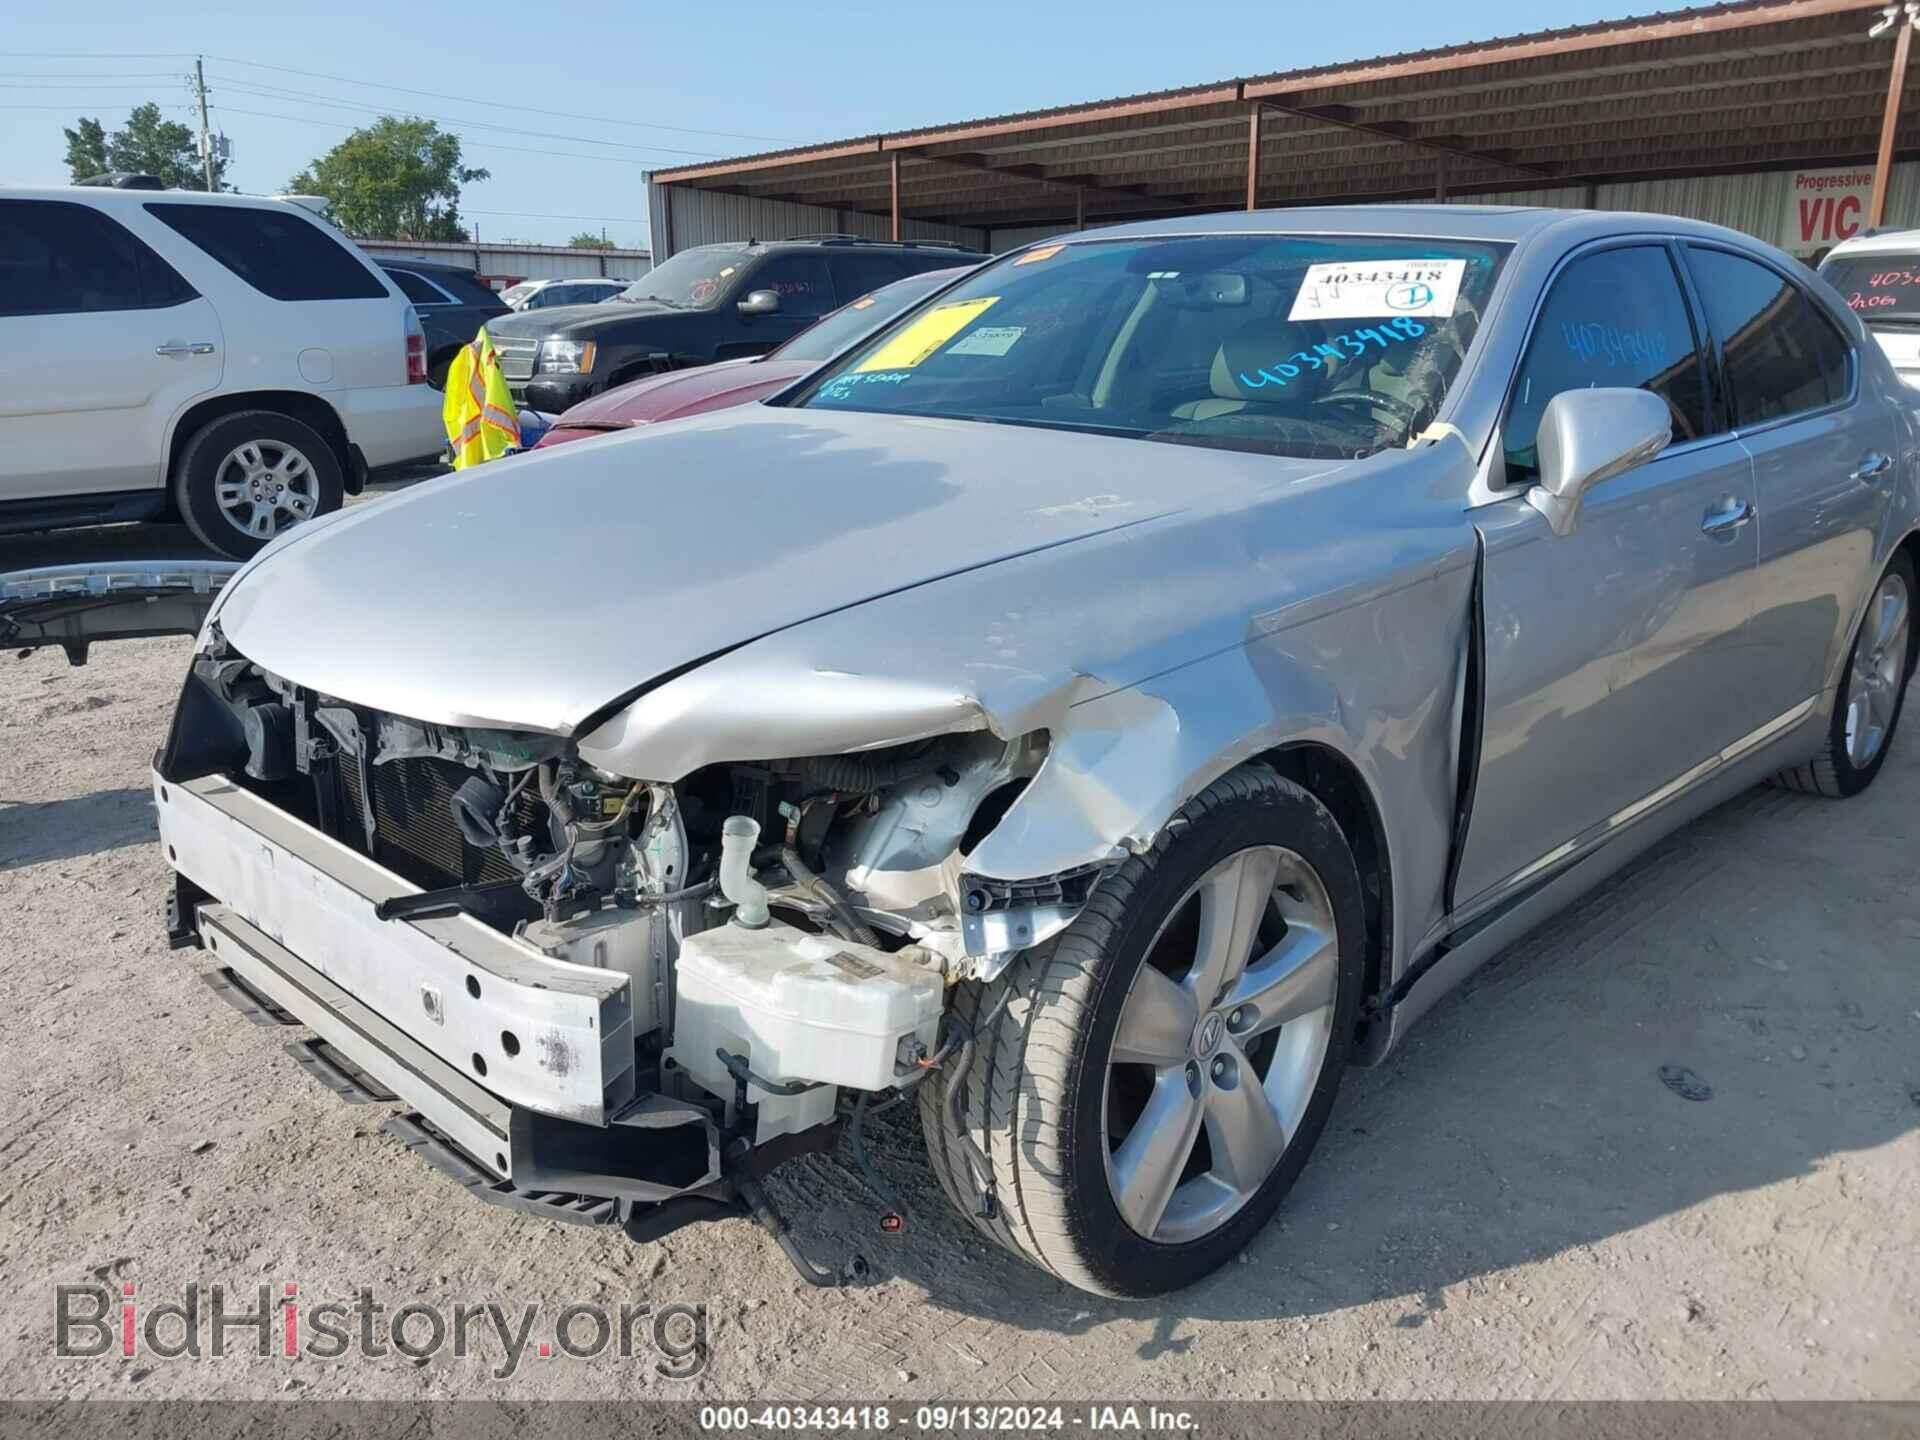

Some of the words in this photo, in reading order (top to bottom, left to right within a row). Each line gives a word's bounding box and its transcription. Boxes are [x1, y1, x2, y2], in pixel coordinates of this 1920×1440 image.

[1795, 172, 1873, 192] Progressive
[1799, 195, 1861, 242] VIC
[1319, 270, 1443, 286] 40343418
[1239, 315, 1425, 388] 40343418
